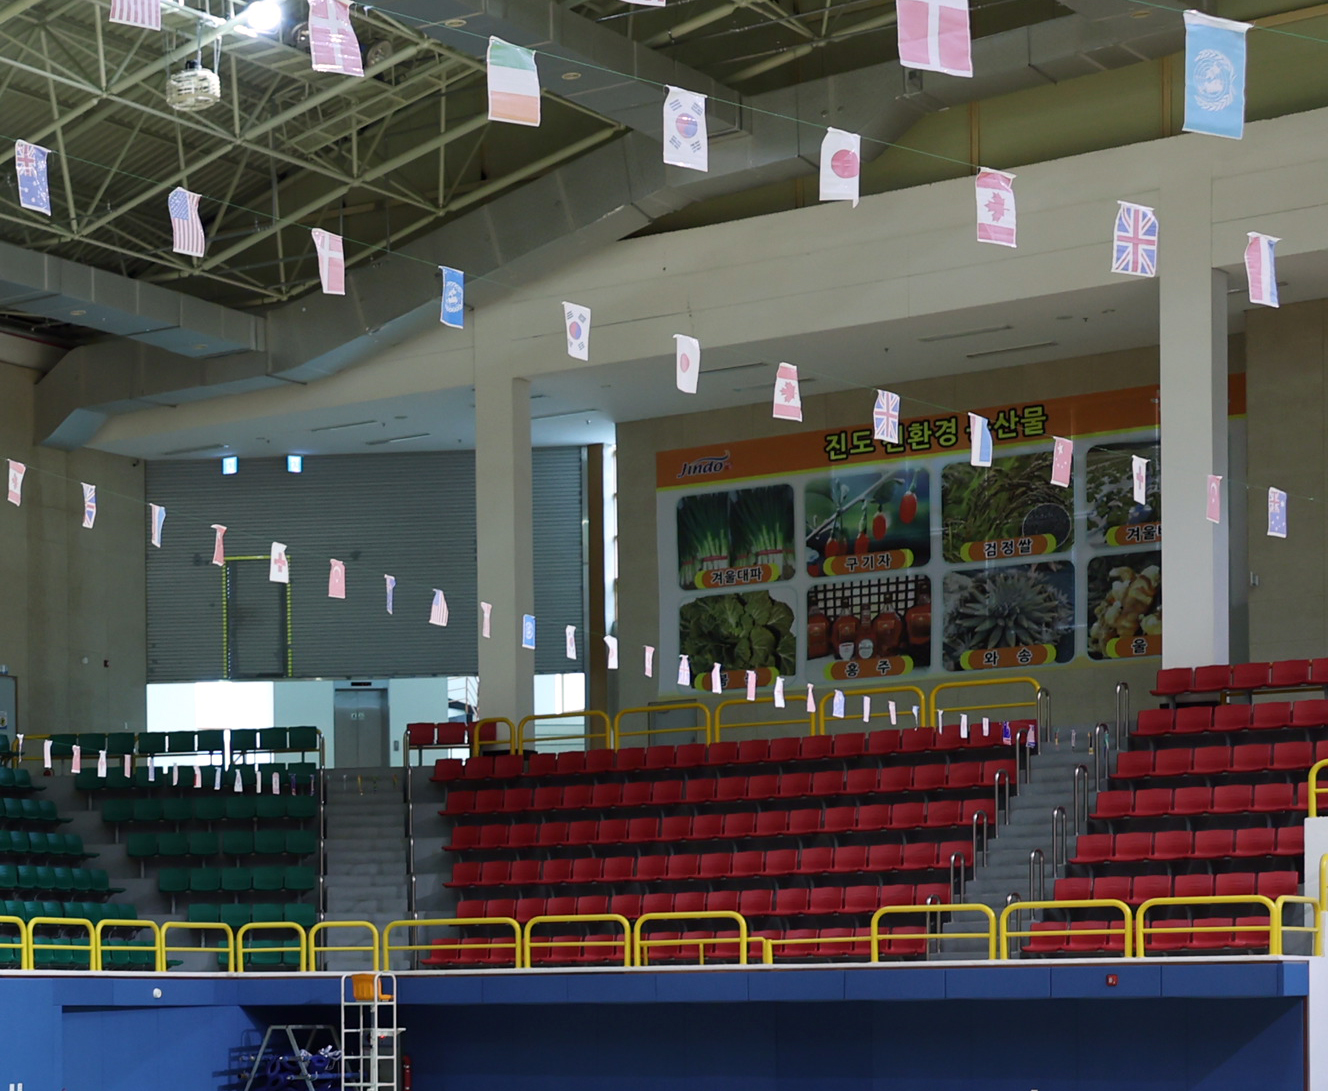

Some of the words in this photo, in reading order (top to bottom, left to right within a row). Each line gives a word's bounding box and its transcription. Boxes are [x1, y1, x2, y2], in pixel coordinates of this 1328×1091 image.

[825, 429, 875, 460] 진도
[965, 406, 1047, 439] 산물
[677, 461, 723, 478] Jindo
[984, 538, 1032, 558] 검정쌀
[845, 553, 891, 572] 구기자
[711, 566, 763, 585] 겨울대파
